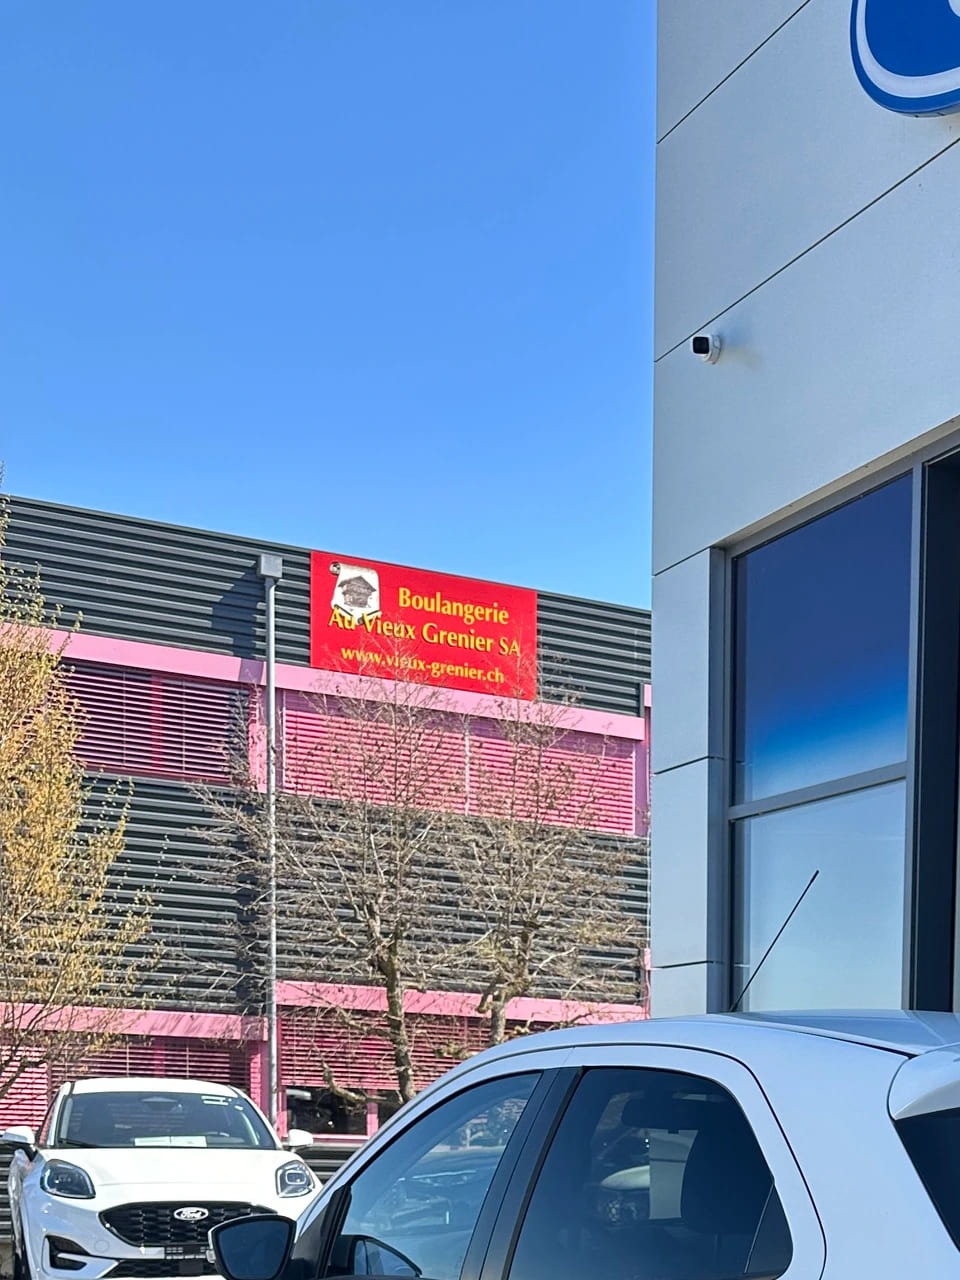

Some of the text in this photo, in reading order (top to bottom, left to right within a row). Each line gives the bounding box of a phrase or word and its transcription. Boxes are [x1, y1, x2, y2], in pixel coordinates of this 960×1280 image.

[398, 587, 510, 625] Boulangerie
[328, 609, 521, 657] Au Vieux Grenier SA
[341, 647, 505, 684] www.vieux-grenier.ch
